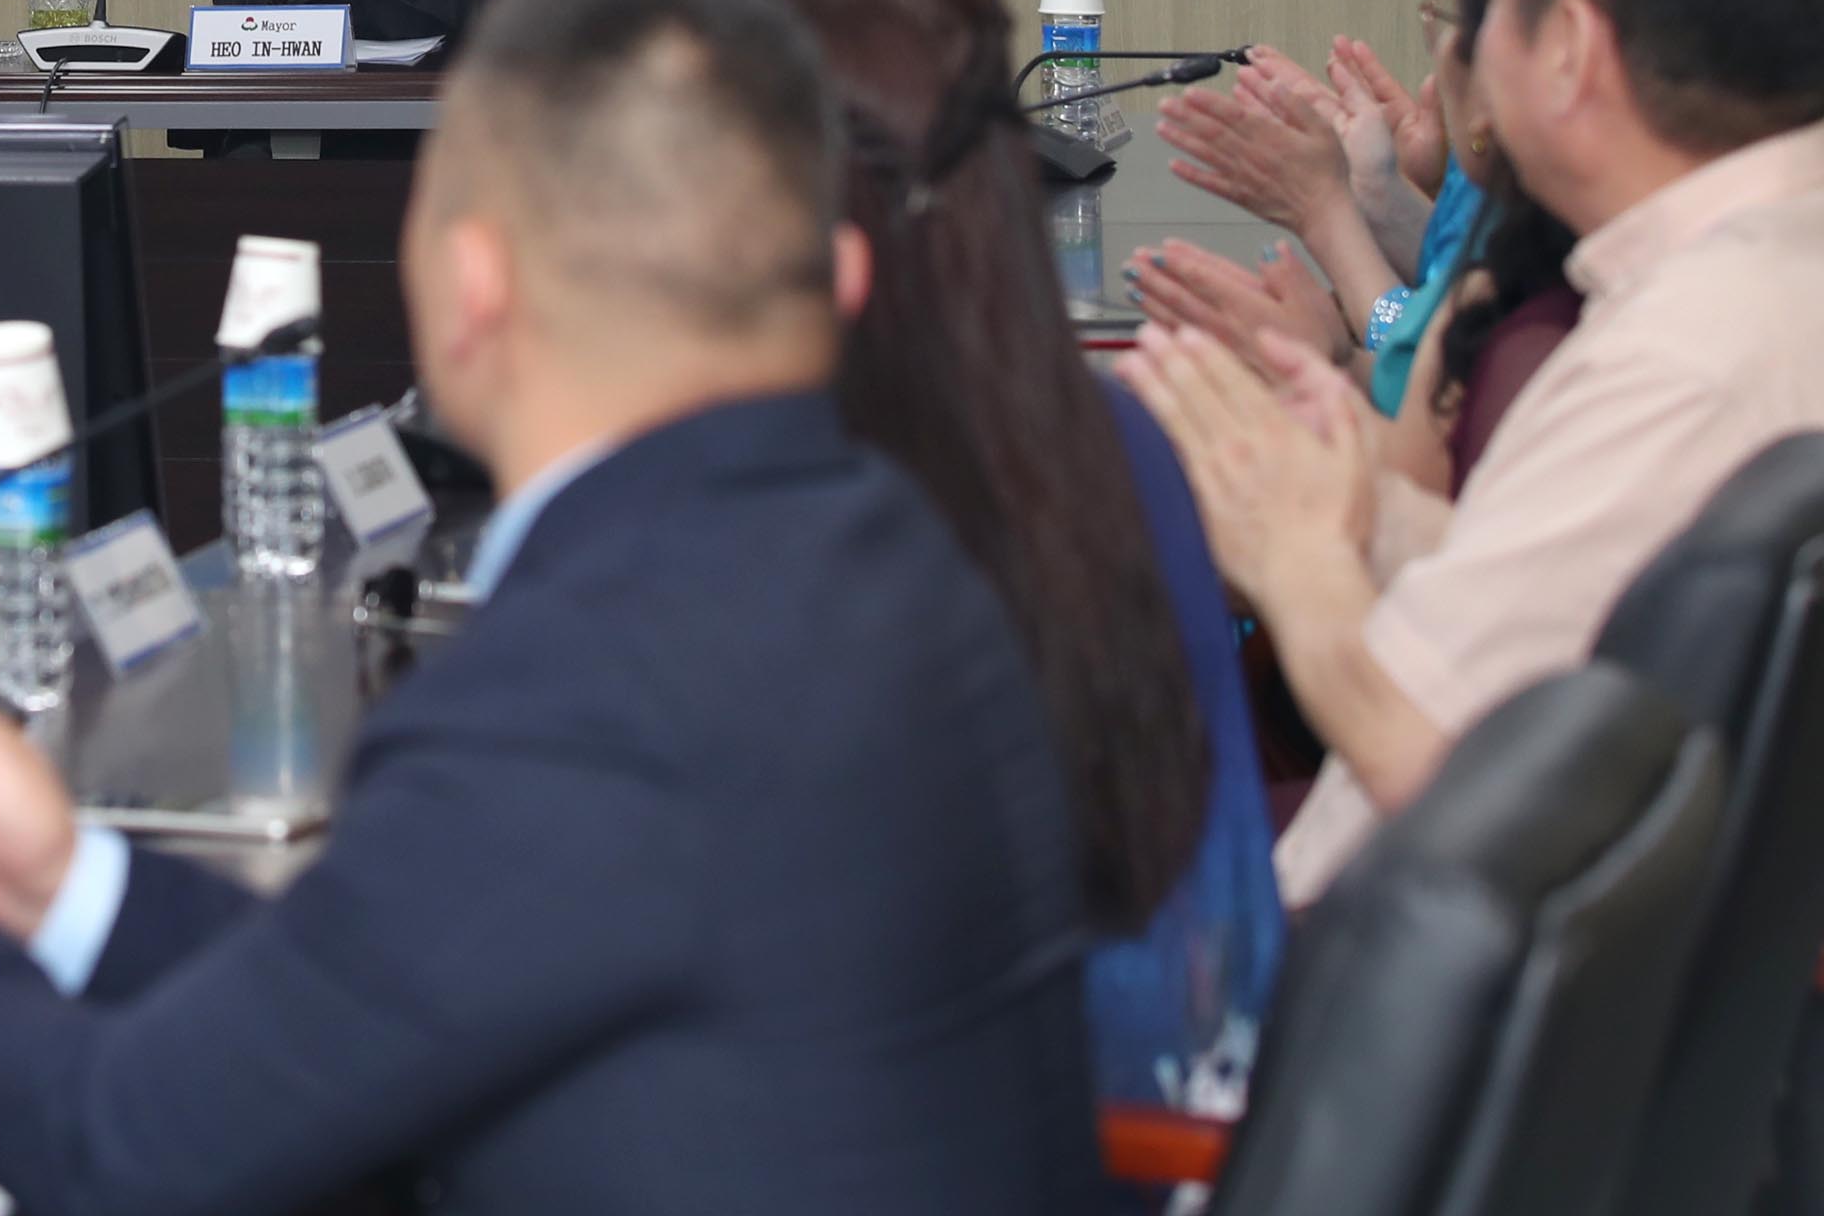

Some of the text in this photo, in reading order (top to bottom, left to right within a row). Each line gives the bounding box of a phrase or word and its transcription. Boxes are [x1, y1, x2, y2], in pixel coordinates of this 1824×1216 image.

[261, 20, 298, 32] Mayor
[211, 40, 323, 57] HEO IN-HWAN
